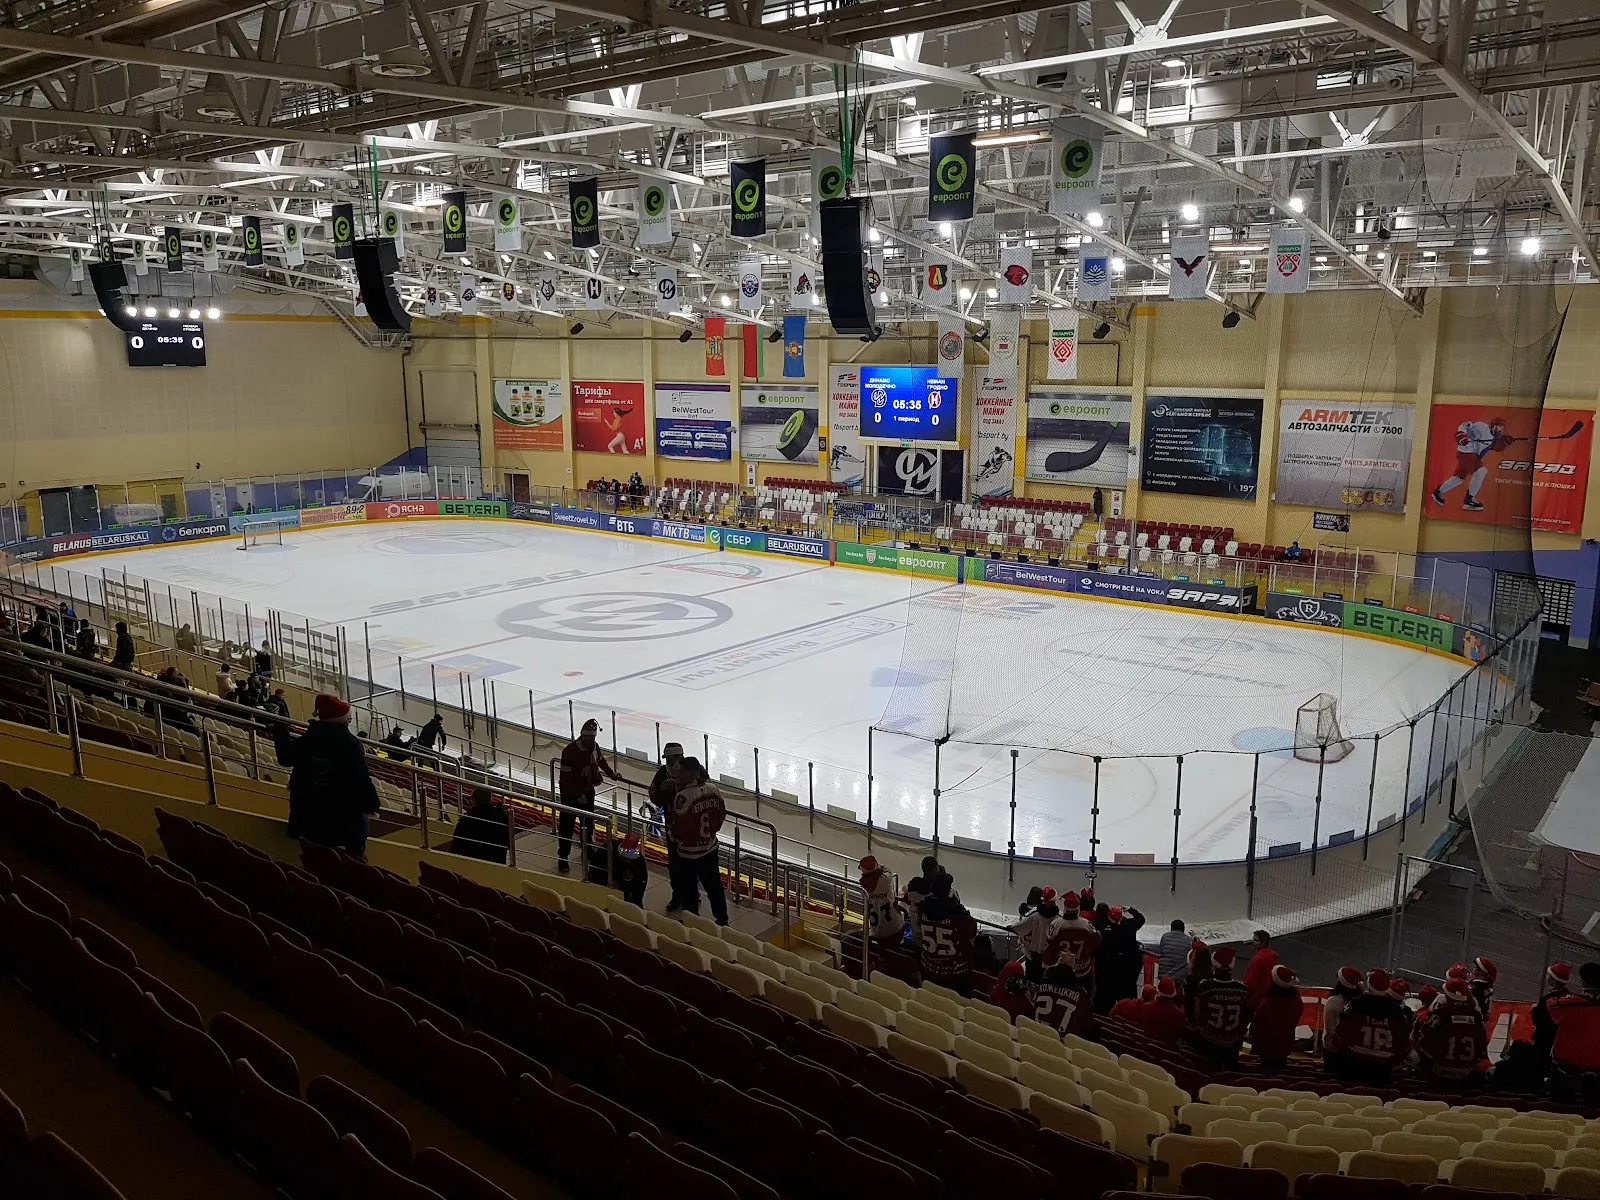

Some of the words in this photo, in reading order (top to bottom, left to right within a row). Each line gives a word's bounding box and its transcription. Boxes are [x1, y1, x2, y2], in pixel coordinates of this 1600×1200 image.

[1055, 179, 1095, 191] евроопт
[933, 191, 970, 203] евроопт
[735, 211, 763, 221] евроопт
[131, 336, 144, 348] 0
[192, 336, 203, 349] 0
[574, 385, 612, 397] Тарифы
[768, 396, 805, 405] евроопт
[838, 401, 858, 410] МАЙКИ
[893, 400, 922, 410] 05:35
[976, 397, 1014, 407] ХОККЕЙНЫЕ
[672, 406, 714, 414] BelWestTour
[983, 407, 1005, 416] МАЙКИ
[1063, 406, 1111, 417] евроопт
[1298, 408, 1394, 425] ARMTEK
[874, 412, 882, 423] 0
[931, 414, 939, 425] 0
[1288, 422, 1371, 434] АВТОЗАПЧАСТИ
[1381, 426, 1403, 435] 7600
[1305, 460, 1341, 468] КАЧЕСТВЕННО
[1315, 454, 1342, 462] ЗАПЧАСТИ
[1498, 460, 1577, 475] ЗАРЯД
[1239, 484, 1255, 492] 197
[1544, 482, 1576, 490] КЛЮШКА
[554, 513, 598, 527] Sweettravel.by
[616, 520, 635, 533] ВТБ
[179, 523, 226, 537] белкарт
[53, 538, 92, 553] BELARUS
[92, 533, 149, 546] BELARUSKALI
[726, 533, 752, 546] СБЕР
[767, 538, 823, 554] BELARUSKALI
[899, 556, 946, 570] евроопт
[1016, 571, 1067, 584] BelWestTour
[1095, 581, 1121, 591] СМОТРИ
[1122, 583, 1135, 592] ВСЁ
[1136, 585, 1146, 593] НА
[1146, 587, 1165, 596] VOKA
[1166, 588, 1252, 608] ЗАРЯД
[920, 924, 957, 956] 55
[1035, 995, 1077, 1033] 27
[1207, 1002, 1241, 1032] 33
[1444, 1036, 1475, 1062] 13
